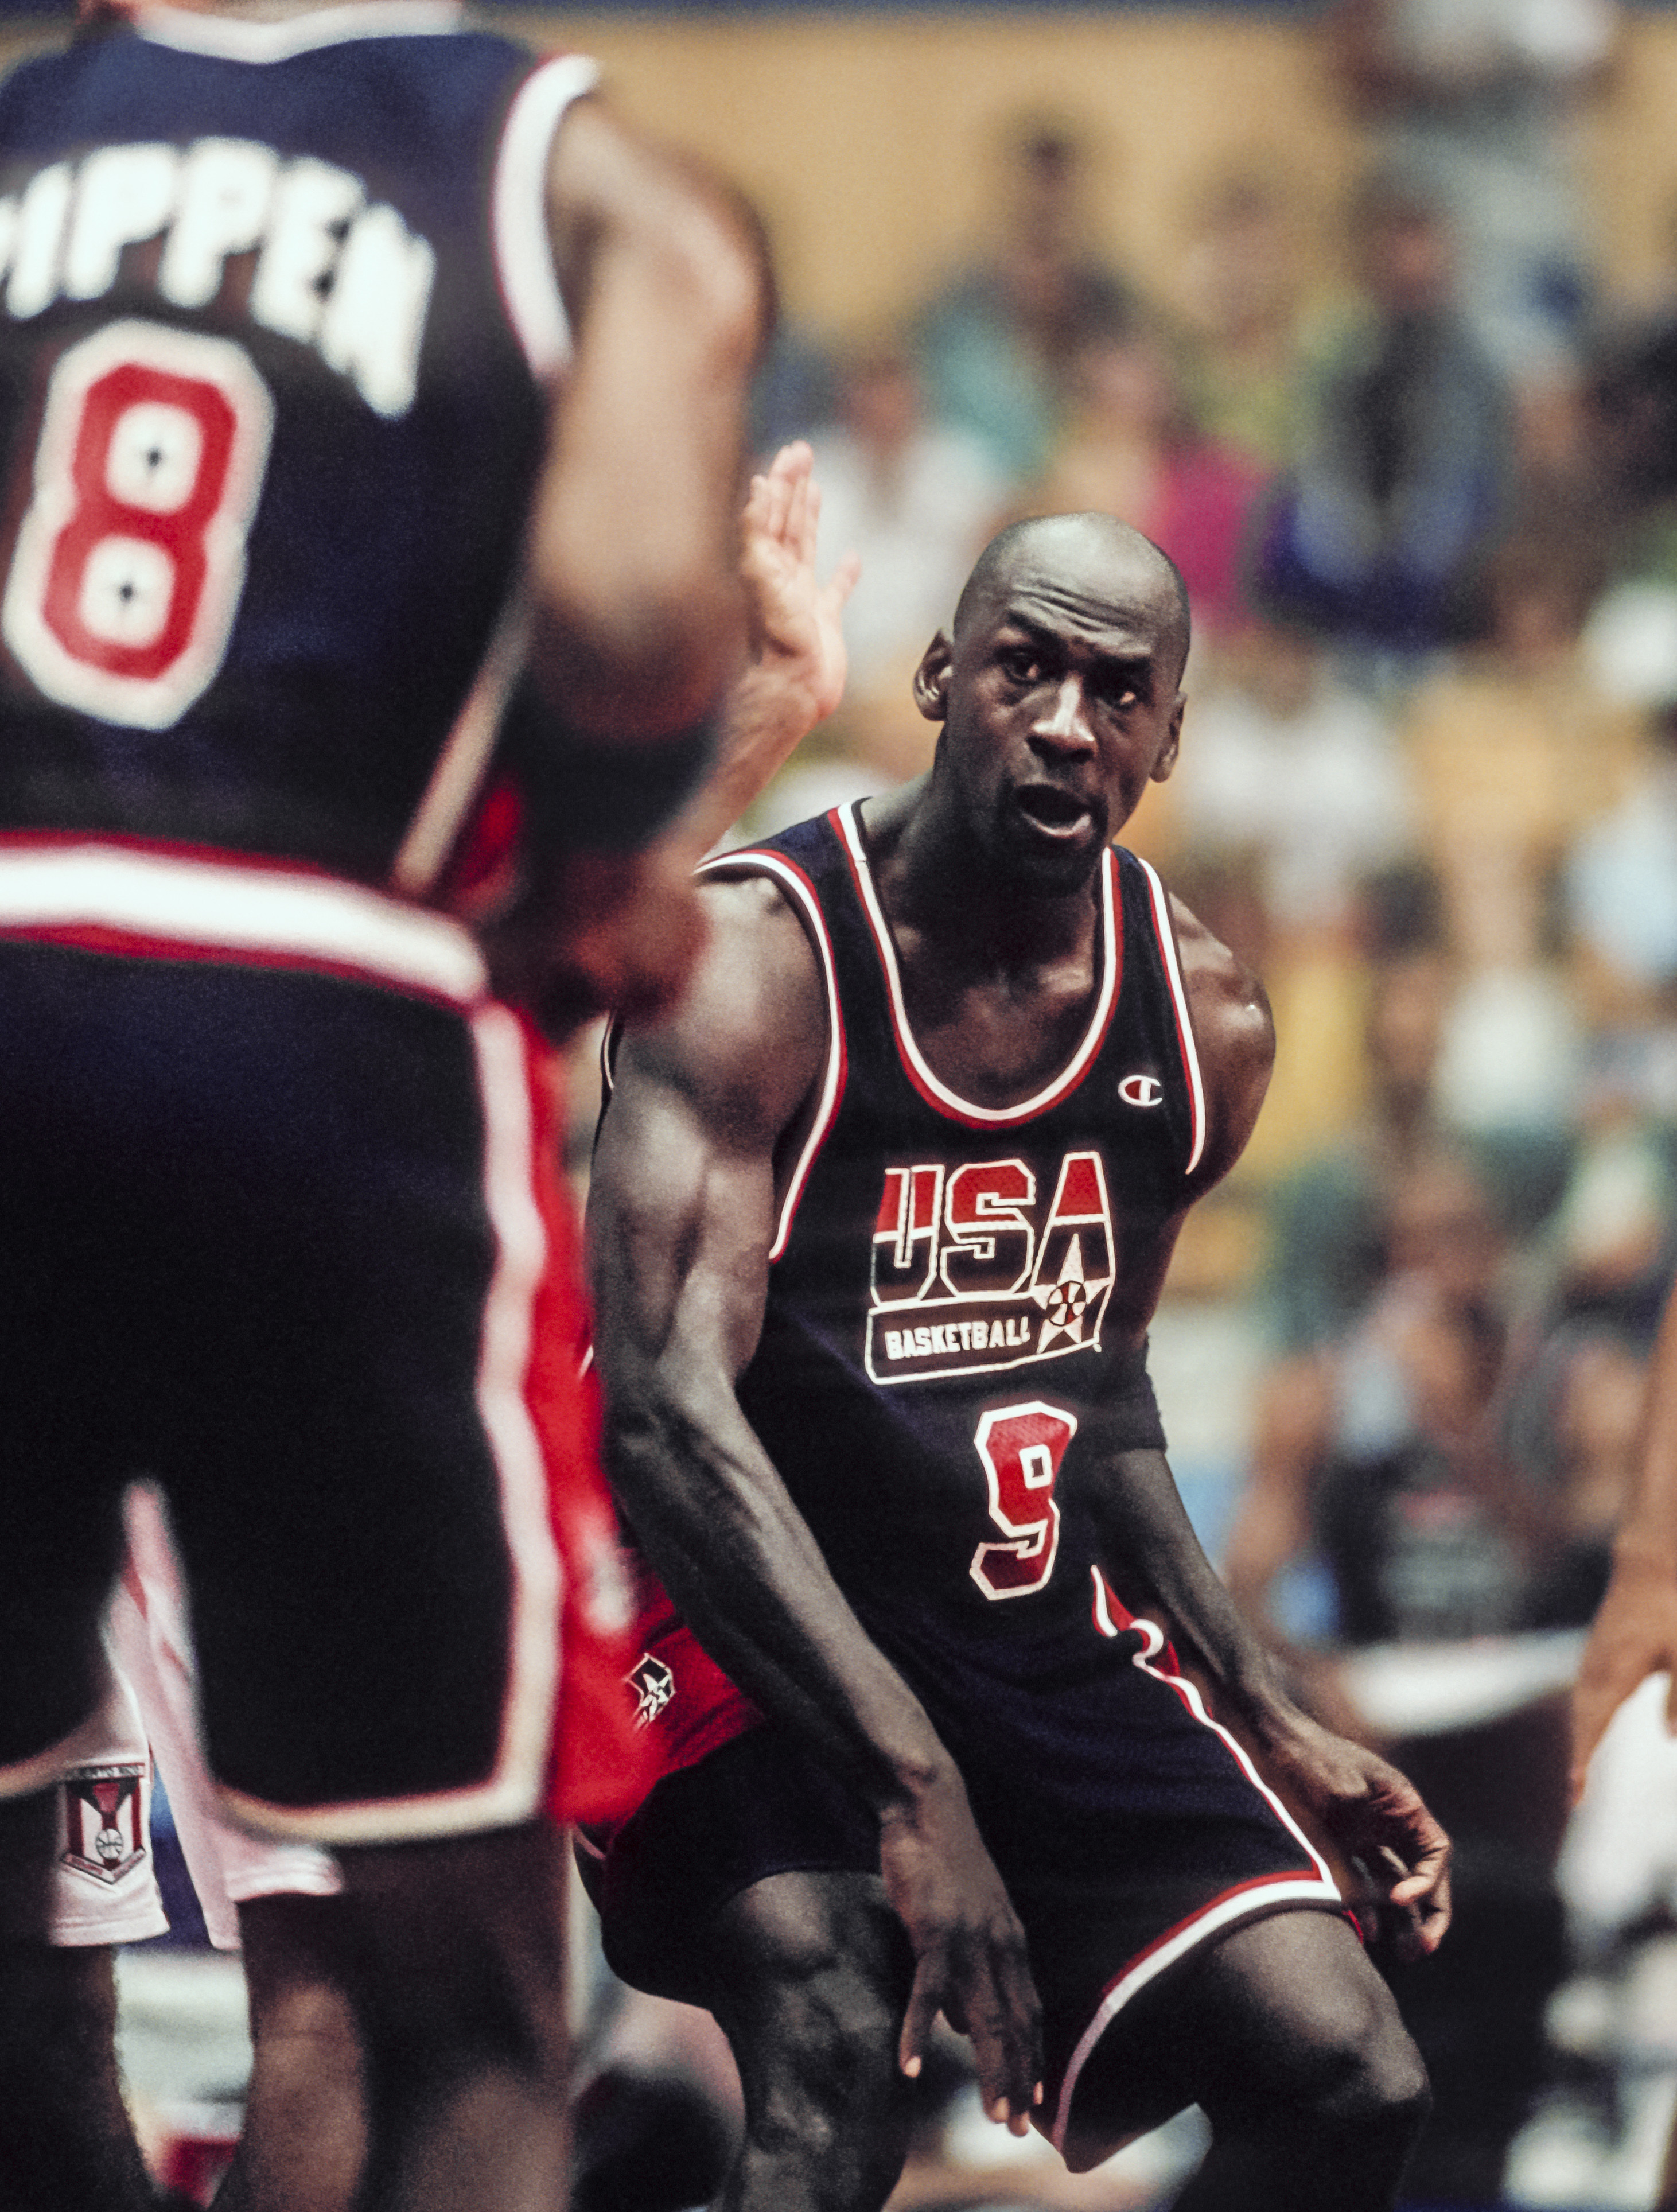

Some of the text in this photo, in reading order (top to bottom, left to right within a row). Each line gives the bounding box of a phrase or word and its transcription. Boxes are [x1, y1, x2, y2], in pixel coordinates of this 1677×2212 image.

[0, 135, 437, 419] IPPEN
[3, 319, 277, 731] 8
[871, 1151, 1116, 1309] USA
[884, 1316, 1030, 1360] BASKETBALL
[970, 1401, 1078, 1601] 9
